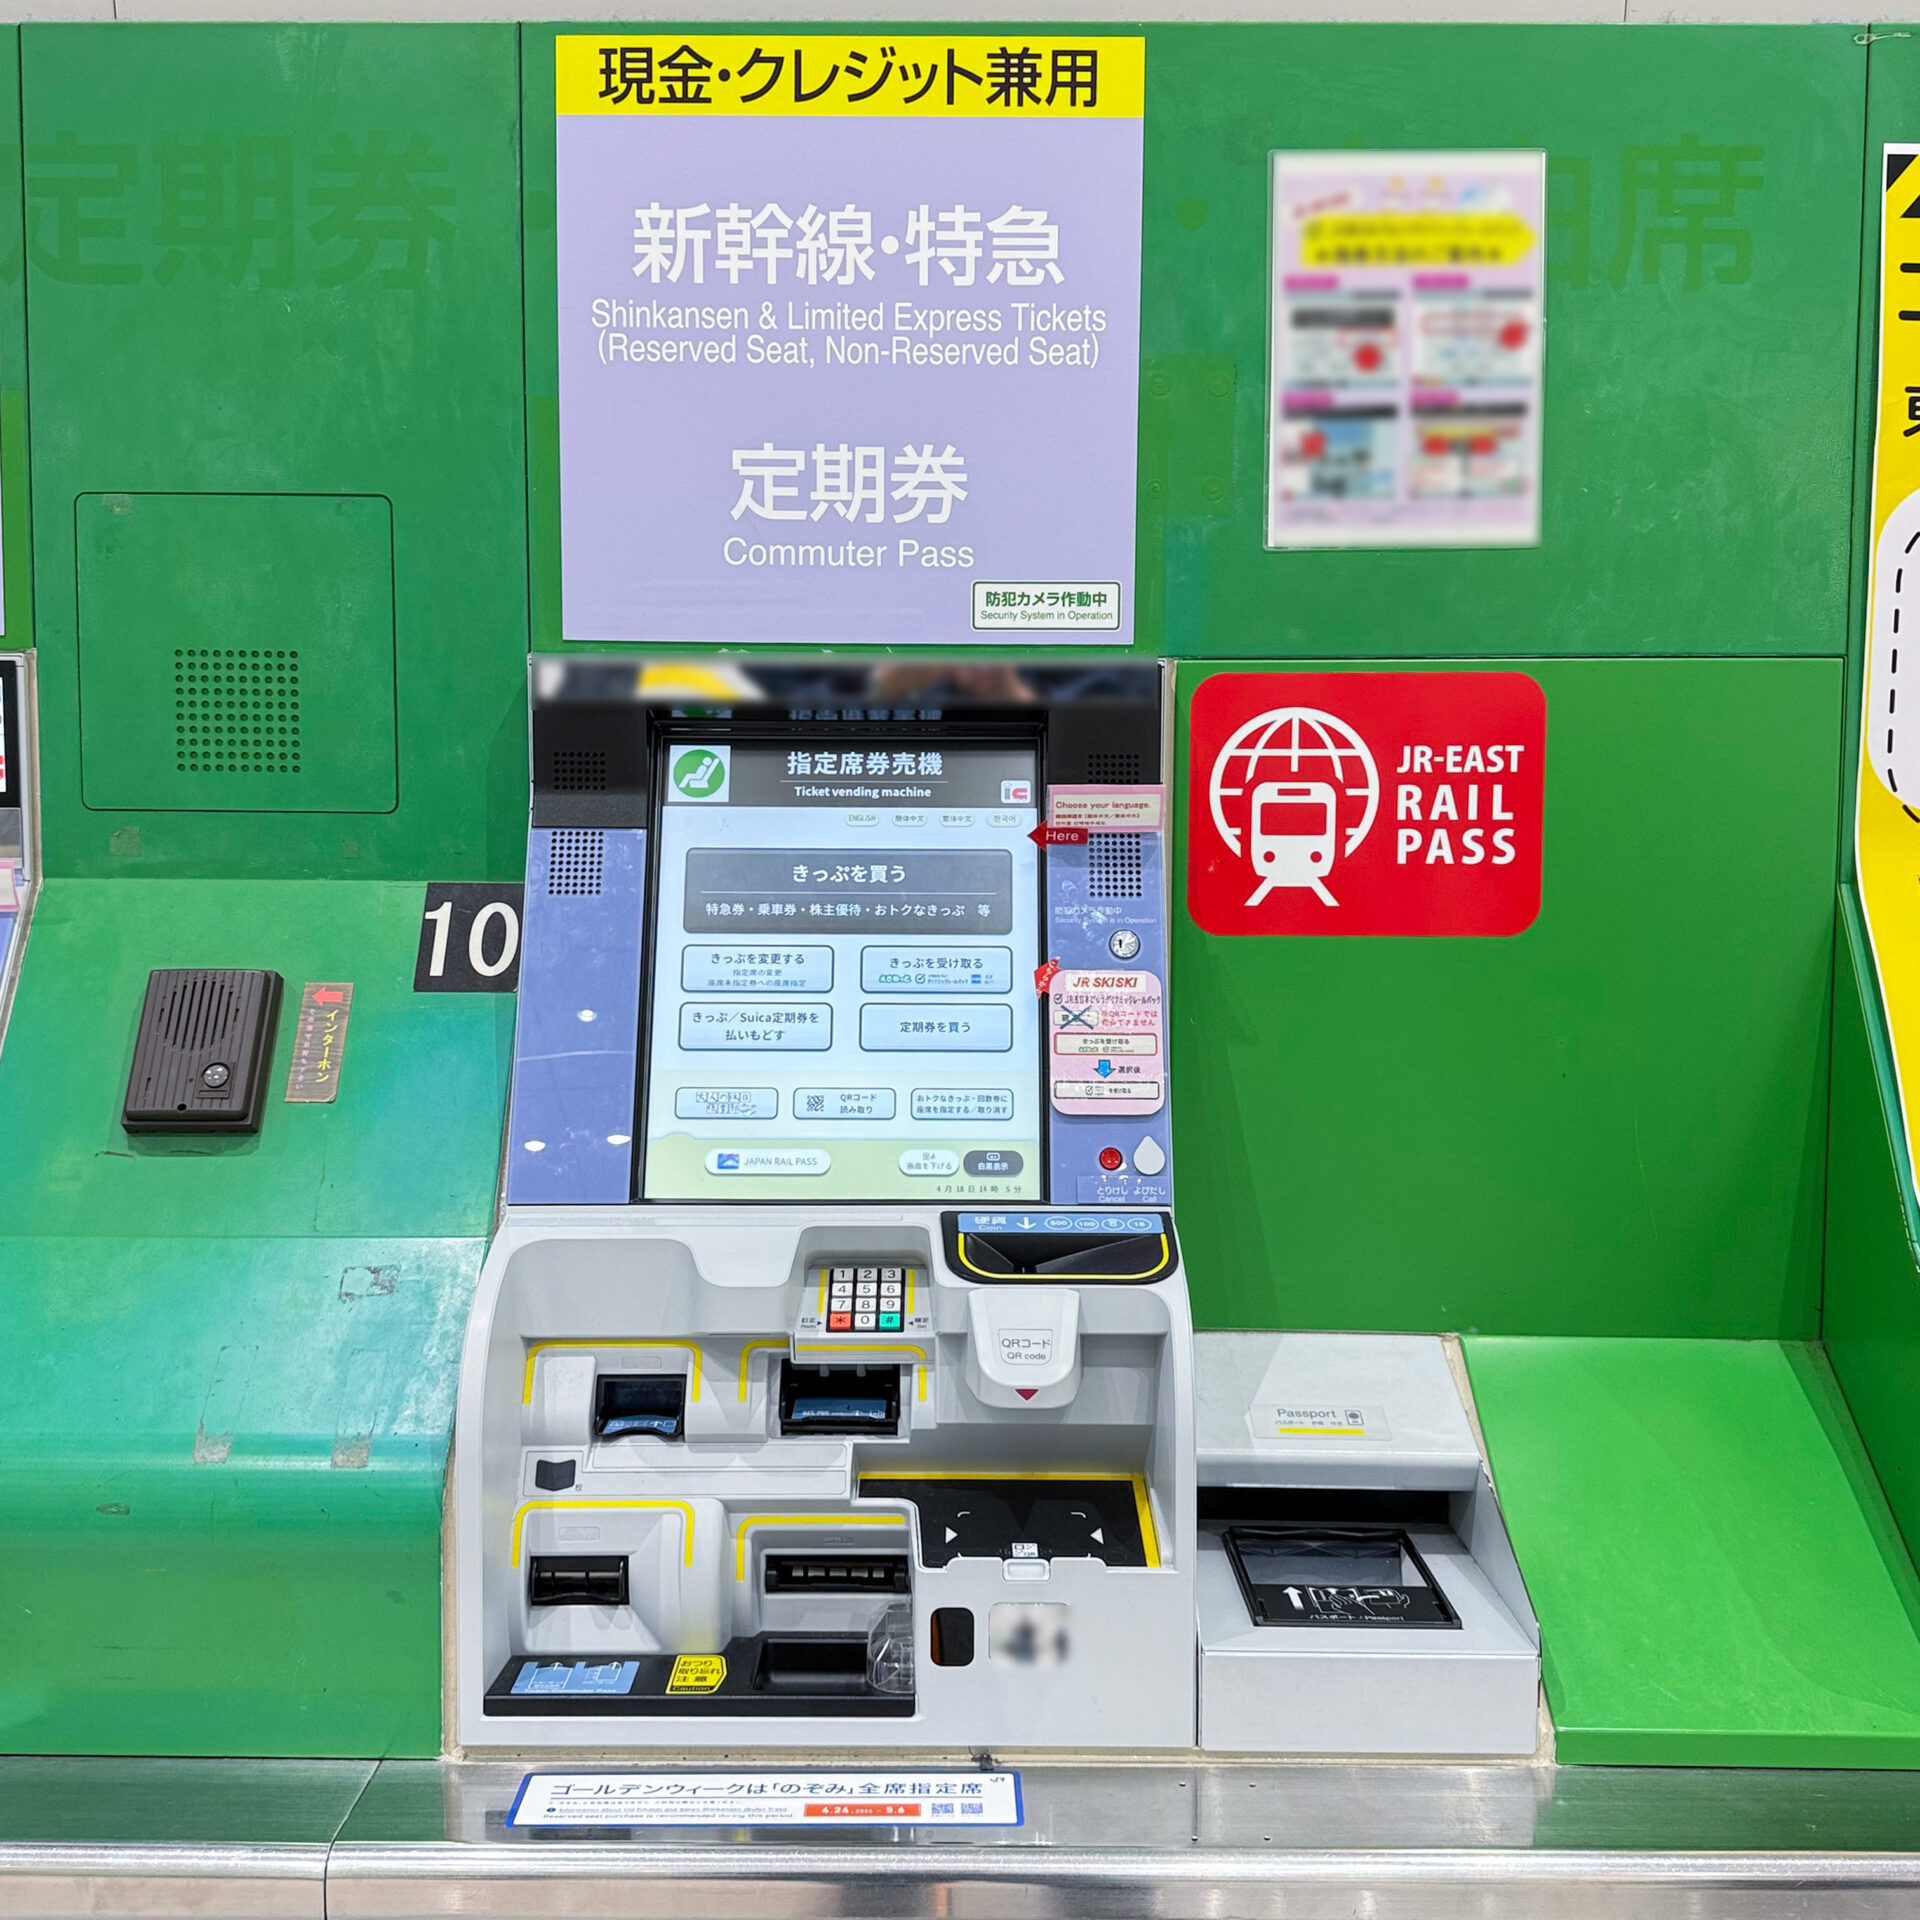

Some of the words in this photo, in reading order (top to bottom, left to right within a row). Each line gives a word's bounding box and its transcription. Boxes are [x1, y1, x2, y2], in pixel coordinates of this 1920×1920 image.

[599, 45, 1098, 107] 現金・クレジット兼用
[633, 202, 1064, 287] 新幹線・特急
[591, 299, 749, 330] Shinkansen
[759, 303, 777, 330] &
[788, 302, 883, 331] Limited
[894, 303, 1001, 338] Express
[1011, 303, 1106, 332] Tickets
[598, 333, 736, 365] (Reserved
[746, 334, 815, 367] Seat,
[826, 336, 1018, 365] Non-Reserved
[1028, 336, 1100, 368] Seat)
[730, 442, 968, 524] 定期券
[724, 537, 886, 567] Commuter
[899, 539, 974, 567] Pass
[986, 592, 1107, 607] 防犯カメラ作動中
[981, 610, 1017, 621] Security
[1020, 610, 1054, 621] System
[1057, 611, 1065, 619] in
[1068, 611, 1112, 620] Operation
[787, 752, 943, 776] 指定席券売機
[1397, 745, 1525, 773] JR-EAST
[794, 786, 830, 797] Ticket
[832, 786, 879, 799] vending
[881, 786, 931, 798] machine
[1055, 801, 1087, 809] Choose
[1090, 803, 1109, 812] your
[1111, 801, 1151, 811] language.
[1397, 784, 1513, 821] RAIL
[1045, 830, 1079, 841] Here
[1397, 828, 1516, 865] PASS
[793, 864, 905, 884] きっぷを買う
[706, 903, 965, 917] 特急券・乗車券・株主優待・おトクなきっぷ
[425, 902, 519, 977] 10
[711, 953, 805, 964] きっぷを変更する
[890, 957, 983, 969] きっぷを受け取る
[1073, 977, 1089, 987] JR
[692, 1012, 820, 1024] きっぷ／Suica定期券を
[900, 1022, 971, 1033] 定期券を買う
[725, 1029, 785, 1041] 払いもどす
[316, 1009, 338, 1082] インターホン
[840, 1093, 877, 1101] QRコード
[917, 1094, 1008, 1103] おトクなきっぷ・回数券に
[840, 1106, 873, 1114] 読み取り
[917, 1106, 1008, 1114] 座席を指定する／取り消す
[744, 1157, 772, 1166] JAPAN
[775, 1157, 793, 1166] RAIL
[796, 1158, 817, 1166] PASS
[1097, 1186, 1128, 1195] とりけし
[1134, 1186, 1165, 1195] よびだし
[840, 1270, 845, 1278] 1
[863, 1270, 872, 1279] 2
[887, 1270, 896, 1279] 3
[838, 1285, 847, 1293] 4
[863, 1285, 871, 1294] 5
[887, 1285, 895, 1294] 6
[838, 1300, 846, 1309] 7
[861, 1300, 870, 1309] 8
[886, 1300, 895, 1309] 9
[861, 1315, 870, 1324] 0
[1002, 1338, 1051, 1349] QRコード
[1007, 1352, 1022, 1360] QR
[1277, 1408, 1336, 1419] Passport
[551, 1782, 983, 1796] ゴールデンウィークは「のぞみ」全席指定席
